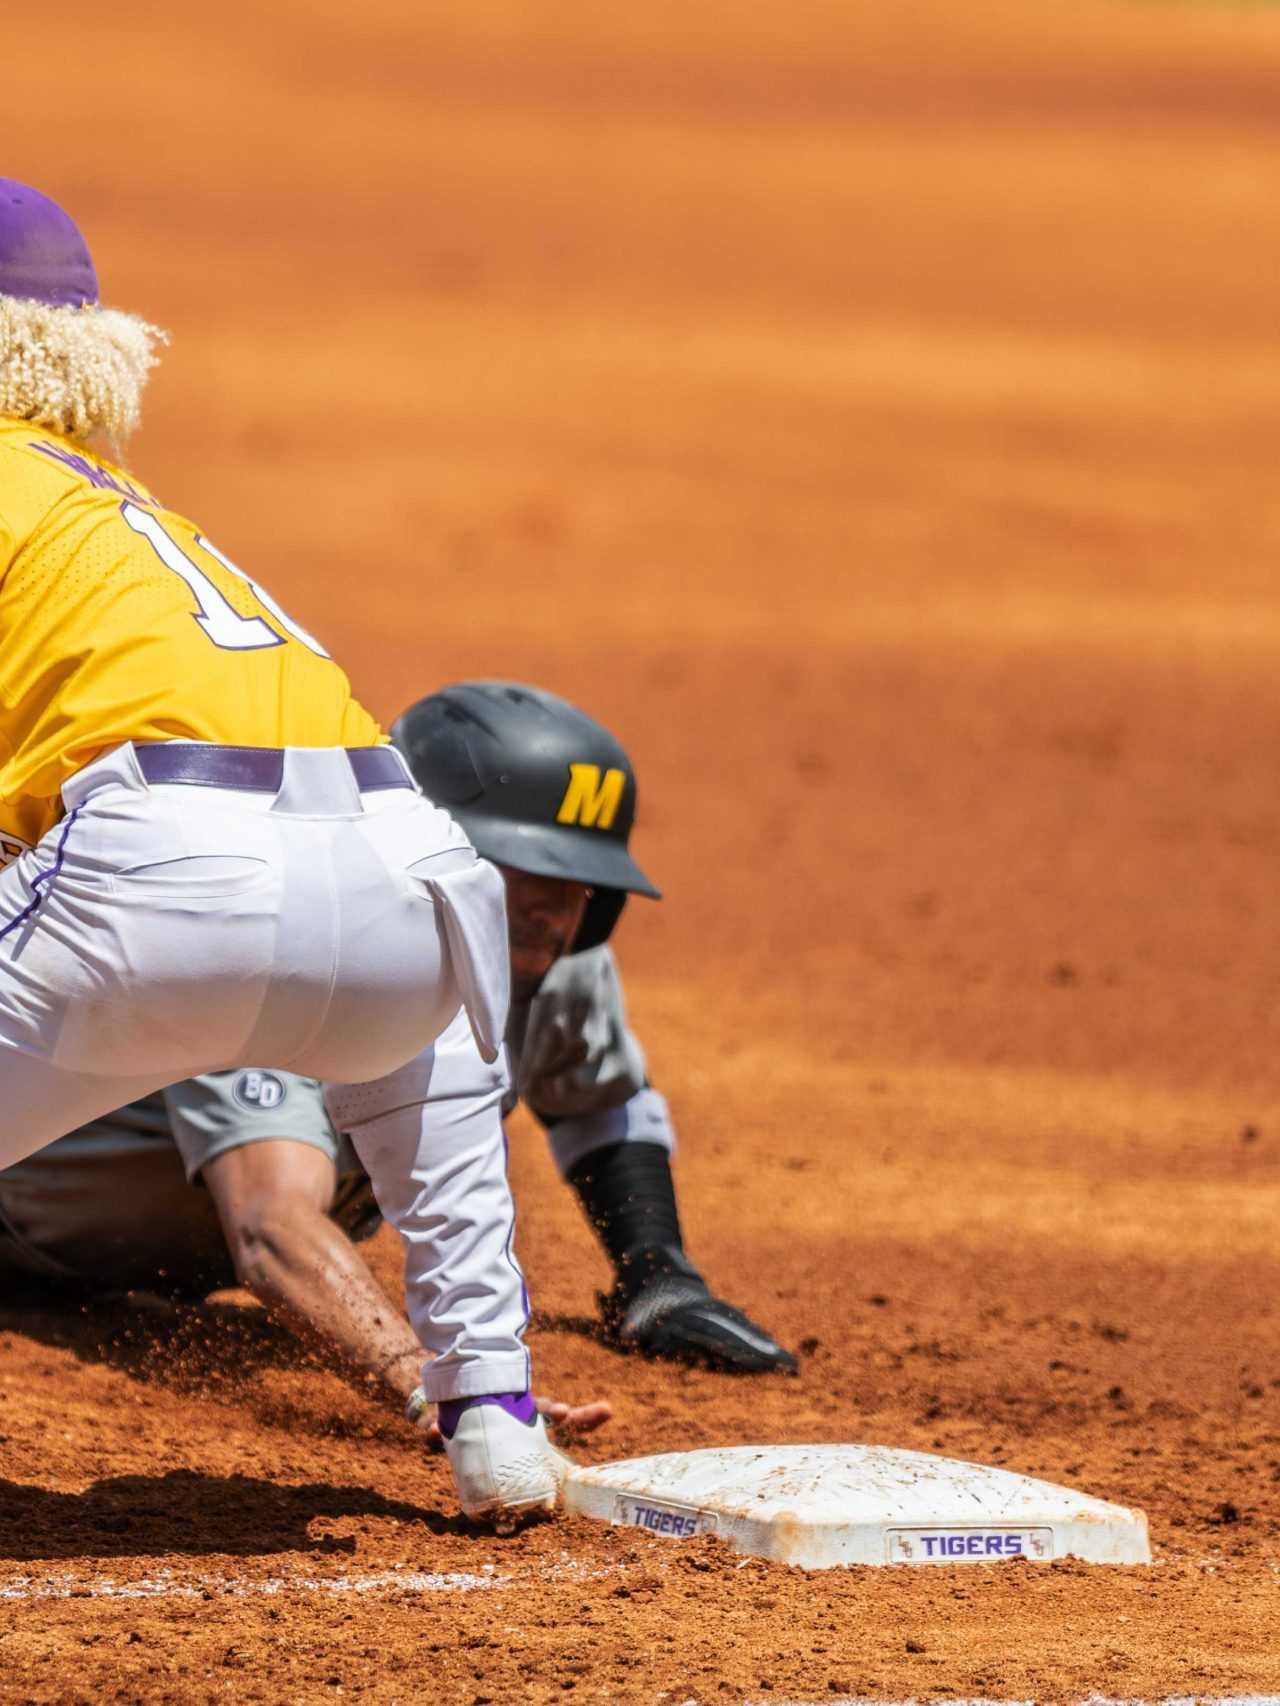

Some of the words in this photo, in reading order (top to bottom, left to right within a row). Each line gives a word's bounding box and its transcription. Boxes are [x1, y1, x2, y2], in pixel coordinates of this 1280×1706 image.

[120, 499, 331, 660] 1
[557, 763, 626, 830] M
[634, 1507, 697, 1536] TIGERS
[921, 1535, 1022, 1556] TIGERS
